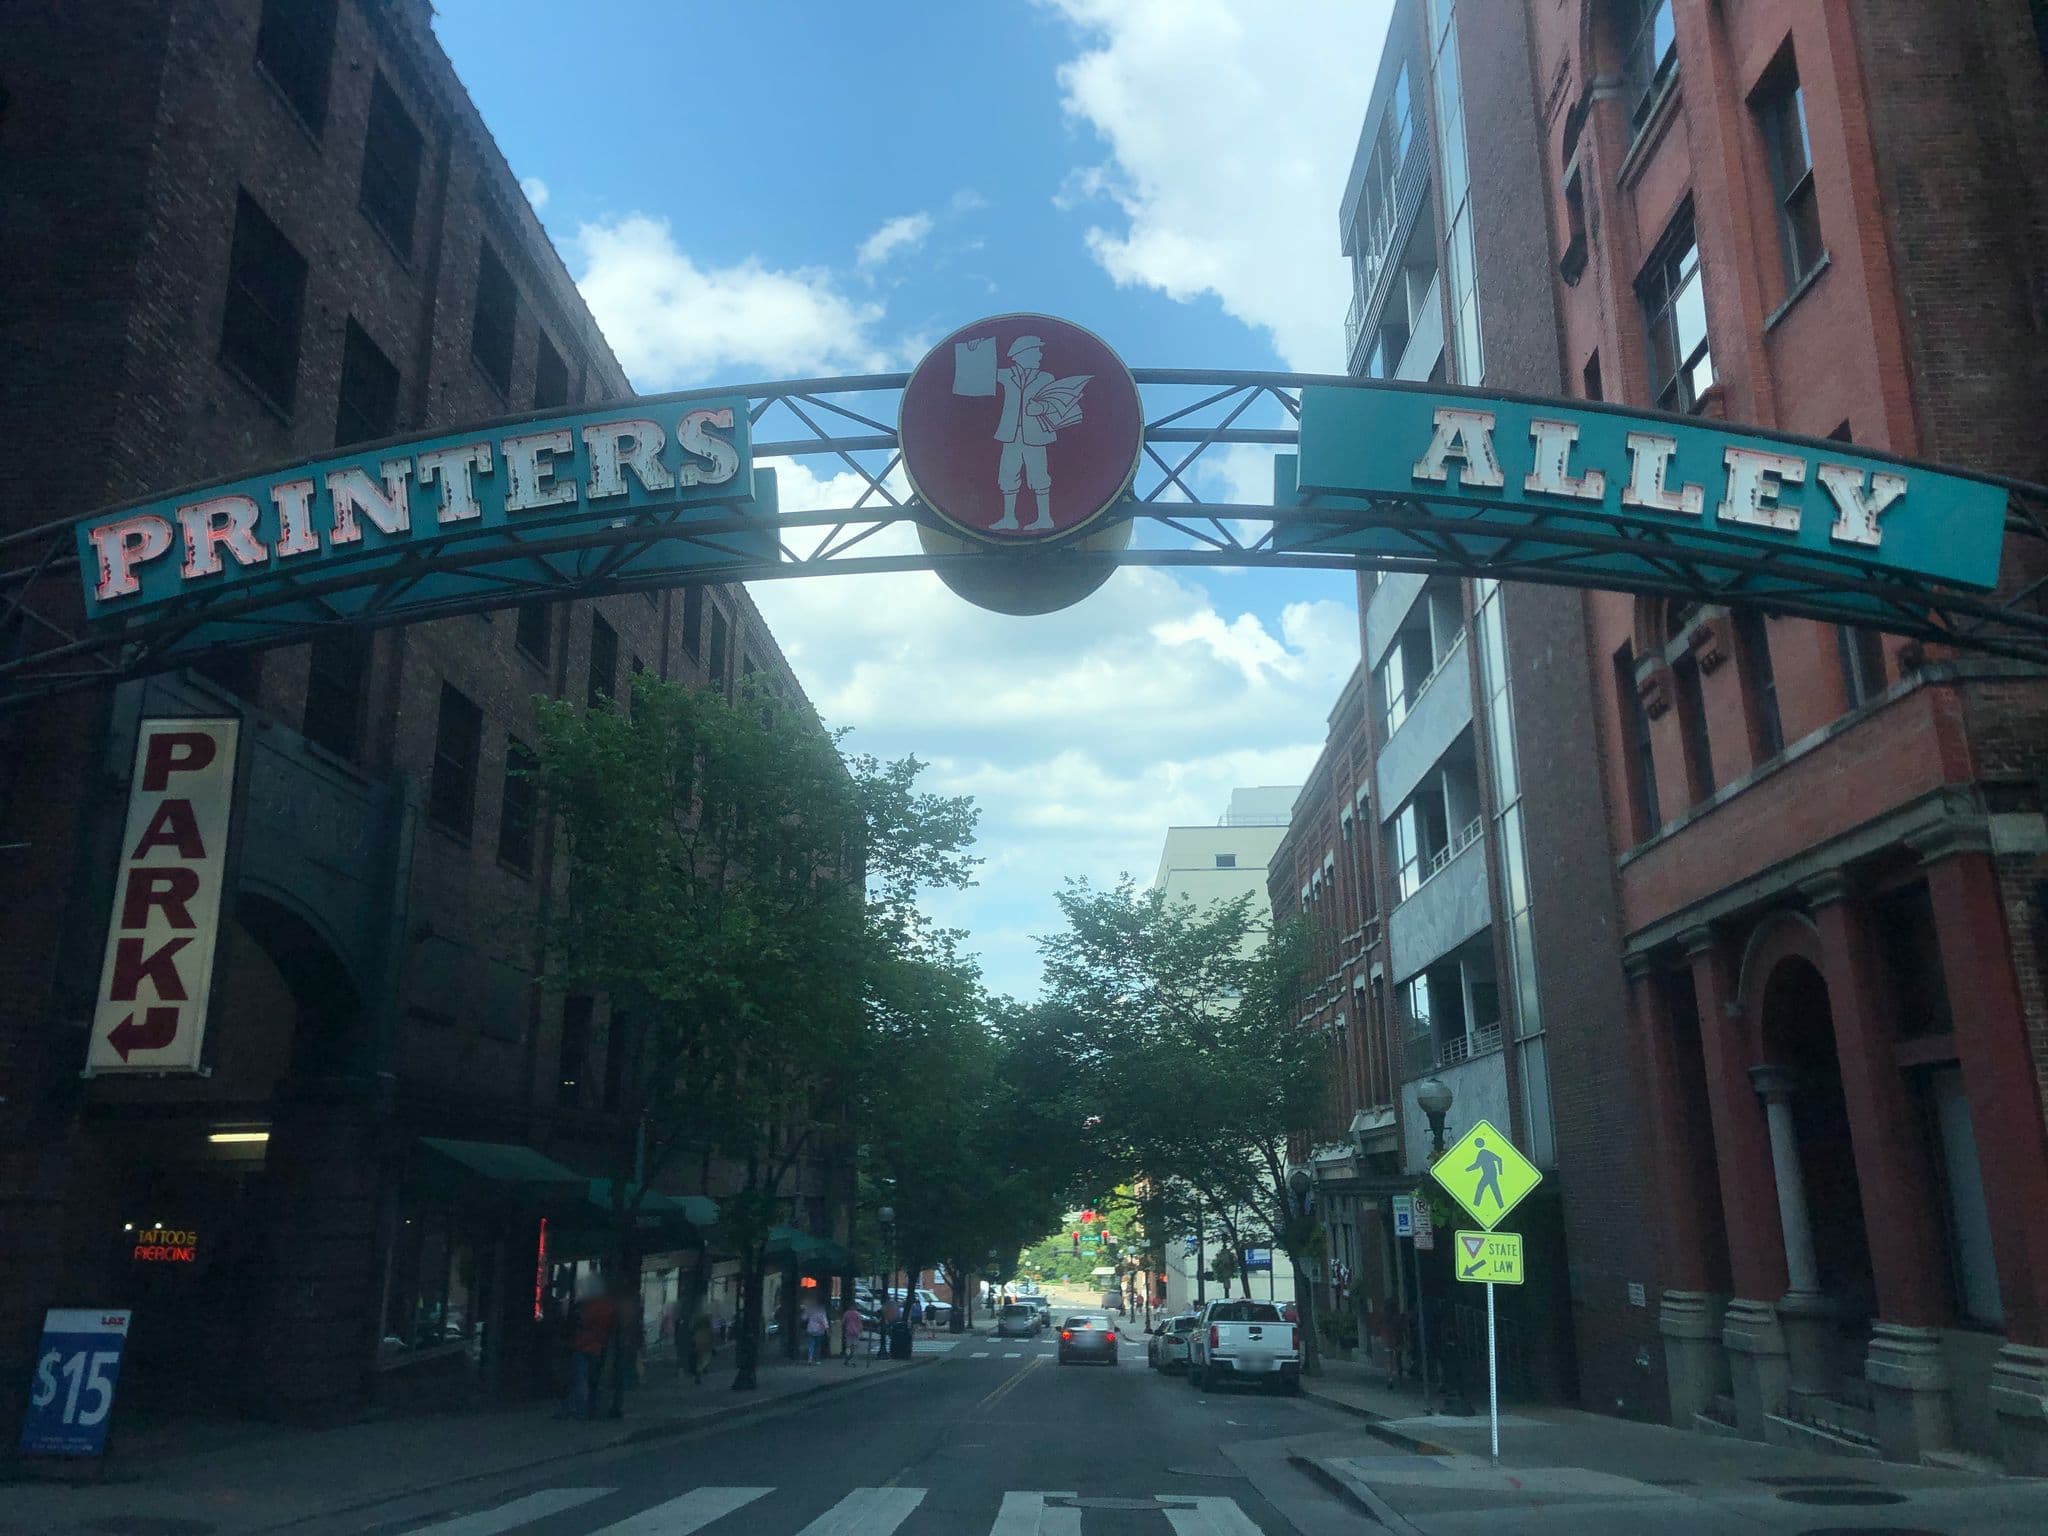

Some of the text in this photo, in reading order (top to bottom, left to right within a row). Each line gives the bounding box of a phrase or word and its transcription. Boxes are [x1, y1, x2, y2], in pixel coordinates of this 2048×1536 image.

[88, 406, 1908, 601] PRINTERS ALLEY
[110, 732, 217, 1001] PARK
[138, 1230, 197, 1245] TATTOOS
[134, 1246, 196, 1262] PIERCING
[1488, 1243, 1518, 1257] STATE
[1493, 1260, 1513, 1273] LAW
[33, 1347, 120, 1426] $15
